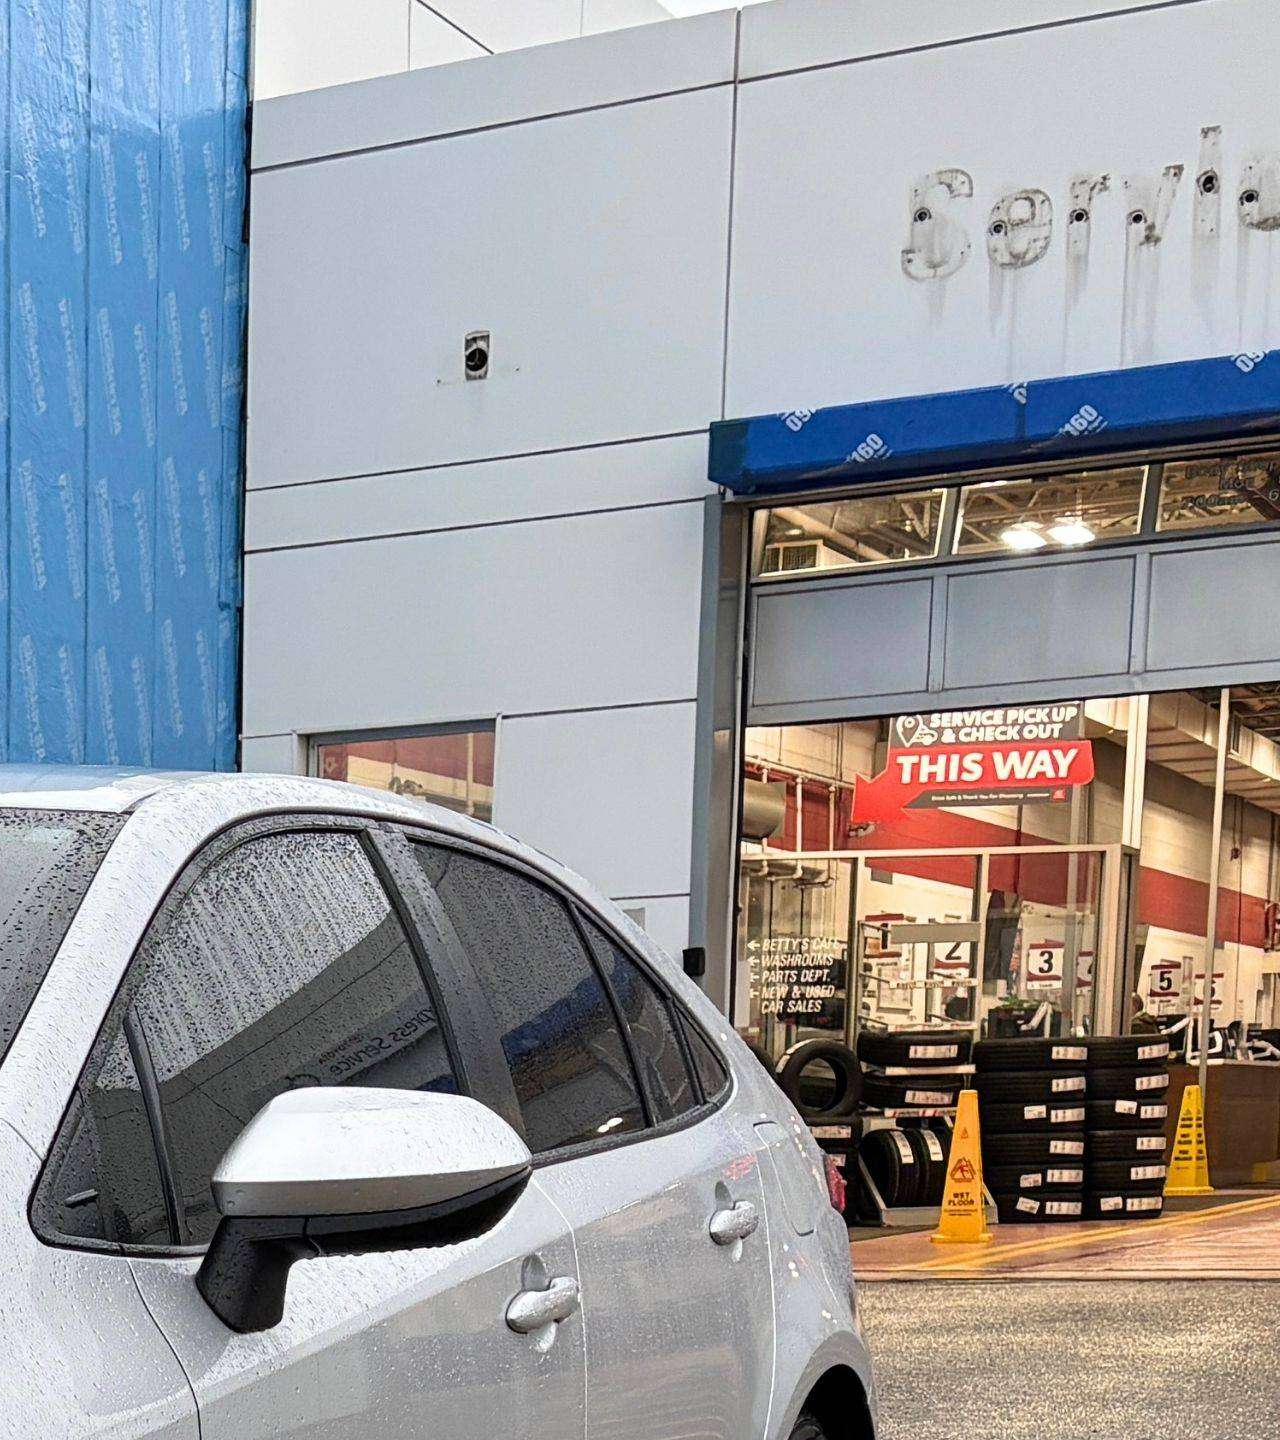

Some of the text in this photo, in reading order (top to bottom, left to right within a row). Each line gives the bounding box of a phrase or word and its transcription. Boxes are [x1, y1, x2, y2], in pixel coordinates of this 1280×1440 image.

[930, 706, 1078, 729] SERVICE PICK UP
[941, 724, 1063, 743] & CHECK OUT
[896, 749, 1079, 784] THIS WAY
[762, 938, 809, 951] BETTY'S
[762, 953, 834, 967] WASHROOMS
[1038, 950, 1054, 974] 3
[762, 969, 831, 982] PARTS DEPT.
[1159, 970, 1173, 991] 5
[762, 985, 835, 998] NEW & USED
[762, 999, 823, 1014] CAR SALES
[953, 1191, 970, 1199] WET
